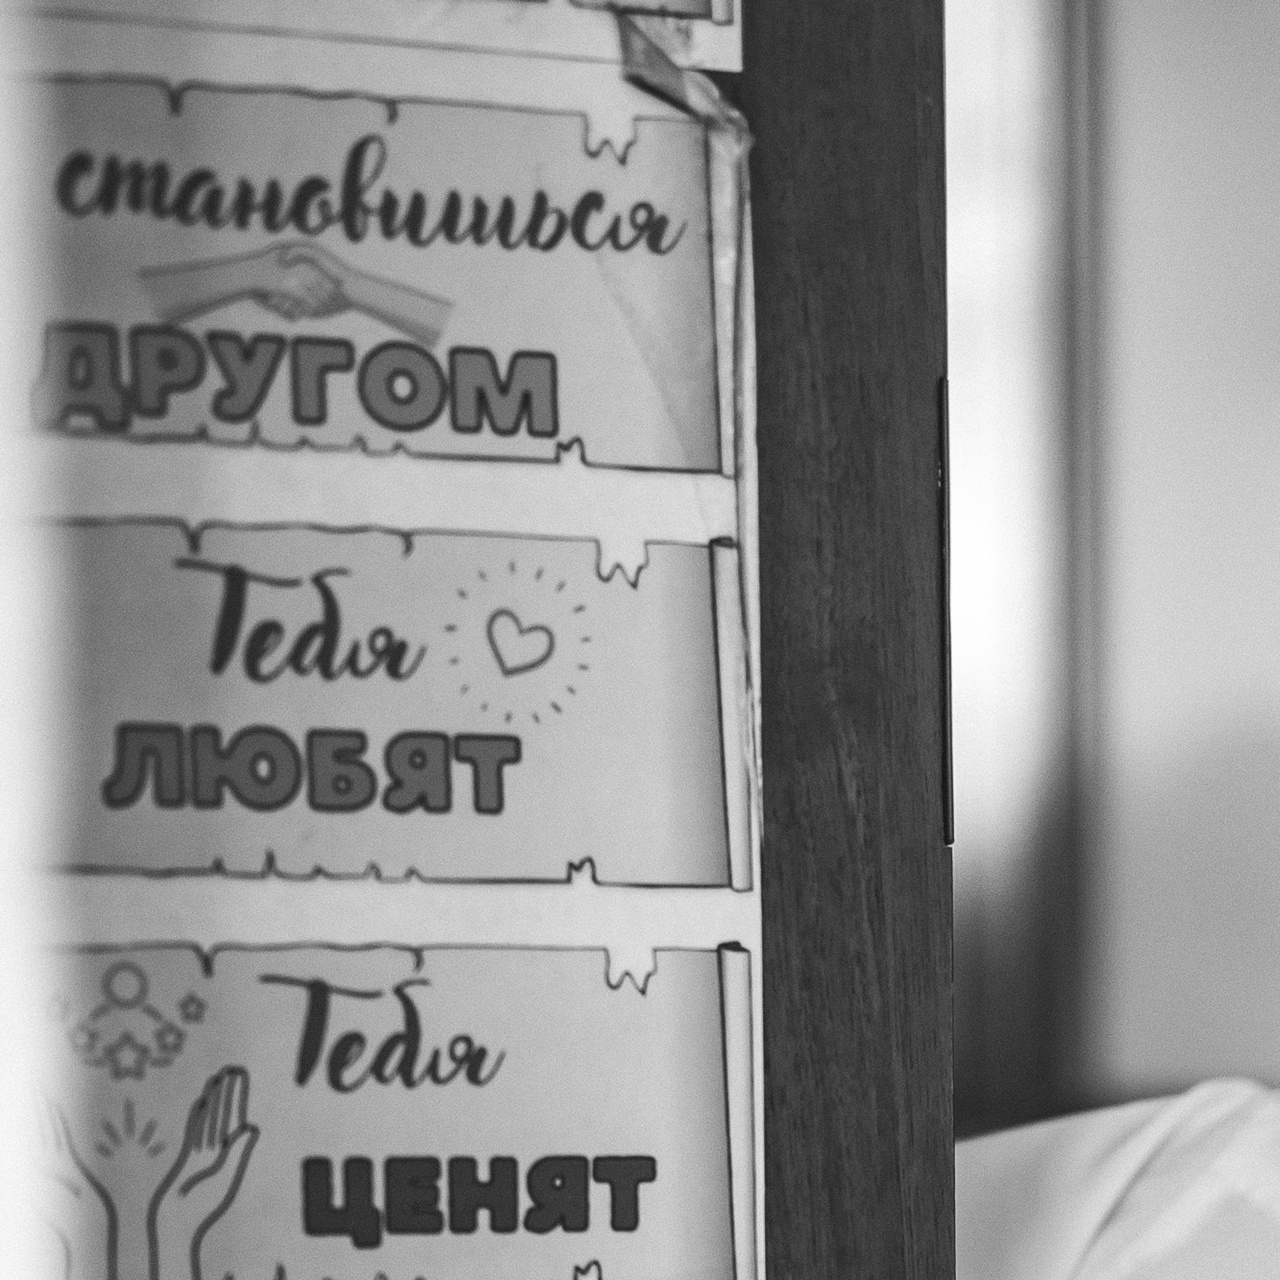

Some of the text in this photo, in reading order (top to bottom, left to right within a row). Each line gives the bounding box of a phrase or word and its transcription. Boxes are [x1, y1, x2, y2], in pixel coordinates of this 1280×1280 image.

[55, 134, 688, 256] становишься
[32, 321, 559, 438] ДРУГОМ
[172, 557, 426, 684] Тебя
[101, 722, 523, 816] ЛЮБЯТ
[258, 973, 506, 1094] Тебя
[301, 1155, 658, 1250] ЦЕНЯТ
